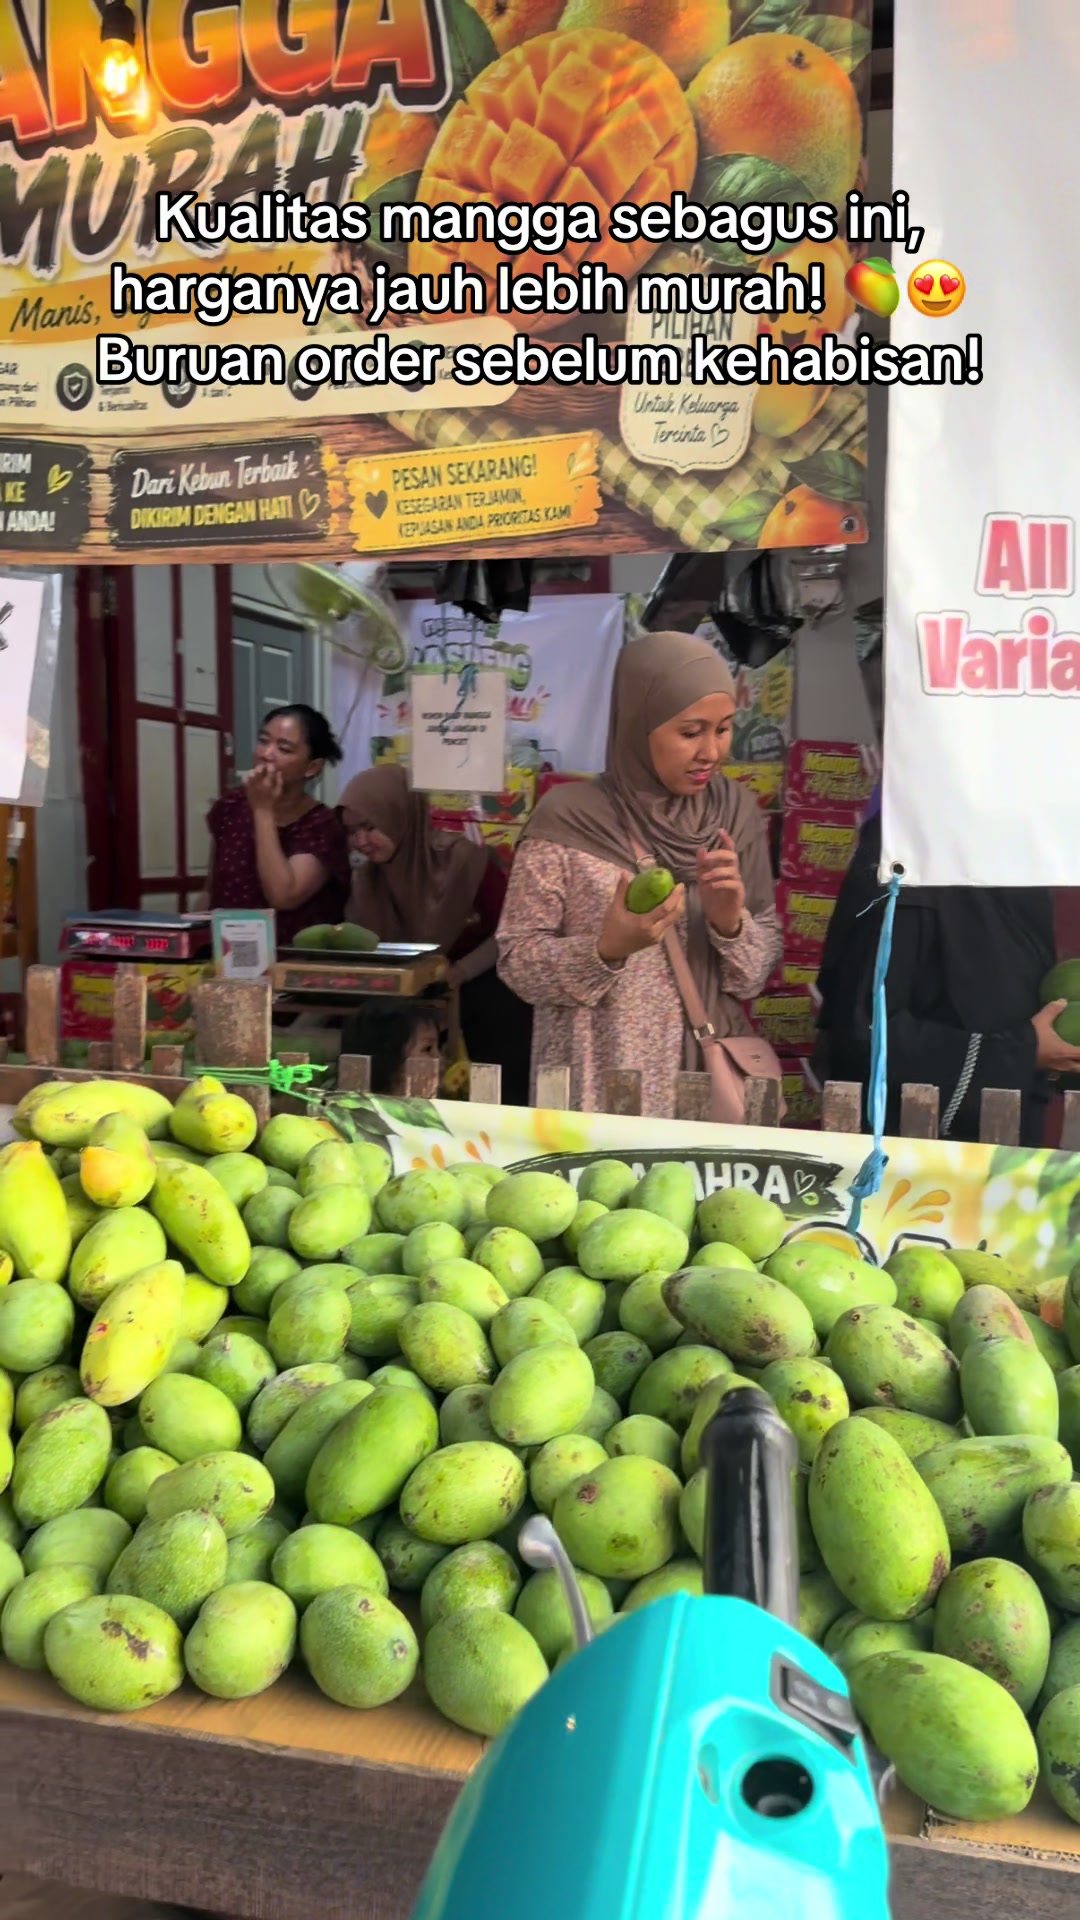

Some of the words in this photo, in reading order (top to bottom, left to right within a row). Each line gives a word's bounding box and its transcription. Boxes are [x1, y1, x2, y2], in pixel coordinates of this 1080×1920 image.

[9, 296, 101, 333] Manis,
[633, 391, 676, 414] Untuk
[677, 393, 740, 421] Keluarga
[653, 420, 707, 445] Tercinta
[131, 468, 175, 498] Dari
[178, 463, 232, 496] Kebun
[234, 451, 300, 489] Terbaik
[392, 463, 443, 492] PESAN
[446, 453, 538, 486] SEKARANG!
[5, 481, 27, 503] KE
[395, 494, 463, 517] KESEGARAN
[465, 487, 526, 509] TERJAMIN,
[6, 510, 57, 532] ANDA!
[130, 503, 192, 530] DIKIRIM
[193, 500, 253, 526] DENGAN
[398, 518, 452, 539] KEPUASAN
[456, 514, 485, 533] ANDA
[486, 508, 542, 528] PRIORITAS
[544, 504, 572, 521] KAMI
[981, 517, 1070, 593] All
